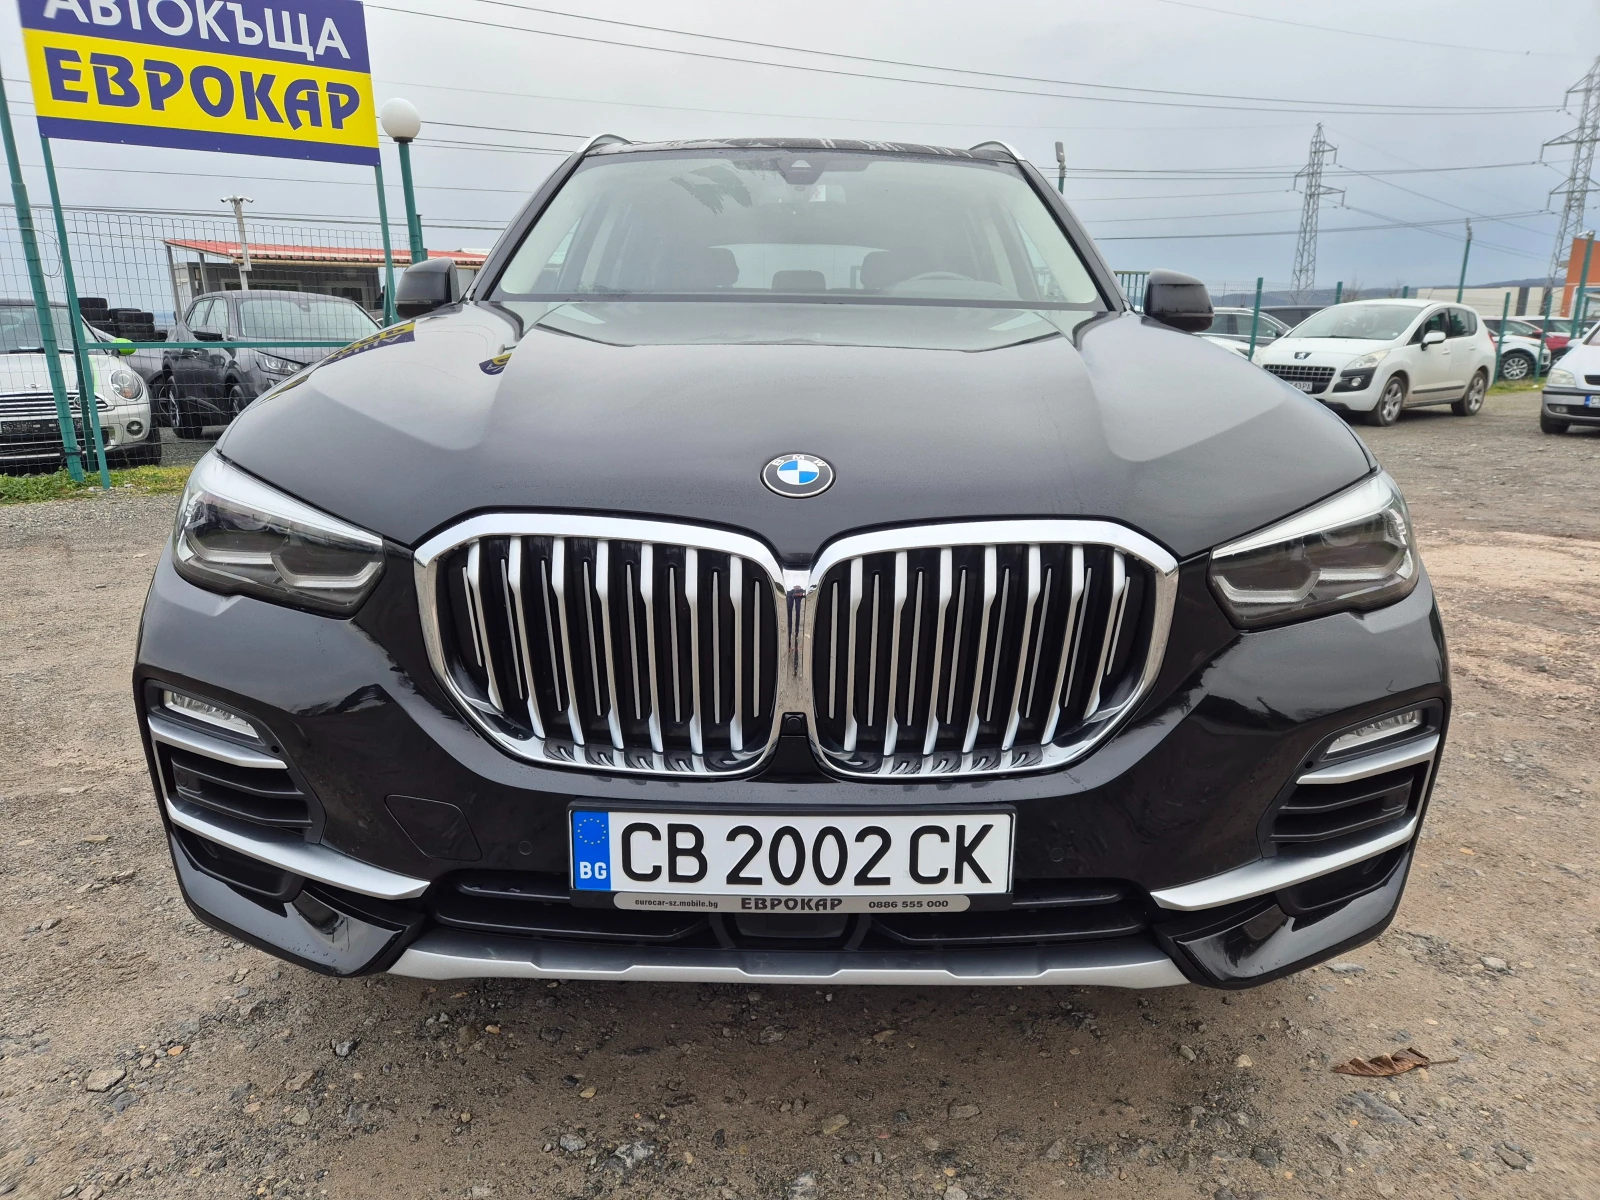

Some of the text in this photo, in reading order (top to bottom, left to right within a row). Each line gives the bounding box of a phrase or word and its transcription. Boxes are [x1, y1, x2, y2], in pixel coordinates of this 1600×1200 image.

[43, 46, 361, 131] ЕВРОКАР
[771, 454, 827, 467] BMW
[621, 822, 994, 886] CB 2002 CK
[579, 861, 607, 880] BG
[634, 899, 718, 909] eurocar-sz.mobile.bg
[741, 897, 843, 912] ЕВРОКАР
[868, 900, 949, 909] 0886 555 000
